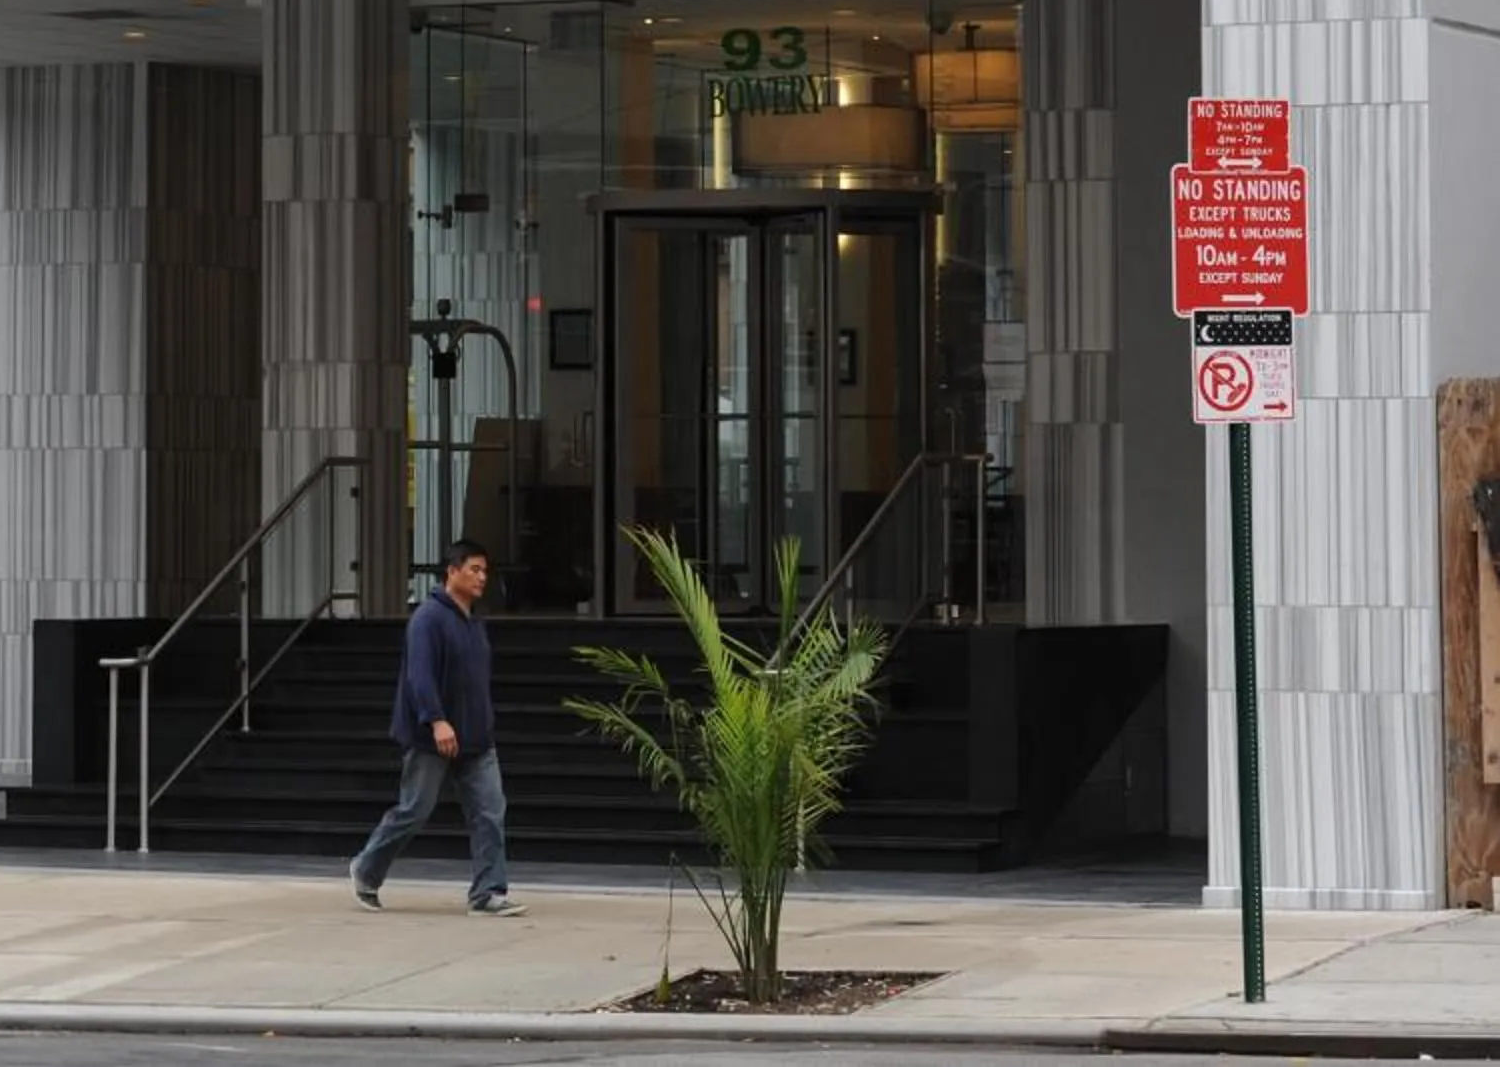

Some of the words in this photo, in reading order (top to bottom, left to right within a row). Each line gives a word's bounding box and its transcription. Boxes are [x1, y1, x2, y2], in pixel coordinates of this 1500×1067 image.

[721, 26, 807, 70] 93
[707, 73, 828, 118] BOWERY
[1197, 105, 1213, 118] NO
[1221, 104, 1283, 118] STANDING
[1206, 148, 1235, 156] EXCEPT
[1178, 180, 1202, 200] NO
[1213, 179, 1301, 201] STANDING
[1189, 207, 1236, 221] EXCEPT
[1243, 207, 1291, 221] TRUCKS
[1178, 228, 1224, 239] LOADING
[1229, 228, 1237, 239] &
[1242, 228, 1303, 239] UNLOADING
[1199, 273, 1237, 283] EXCEPT
[1242, 273, 1284, 283] SUNDAY
